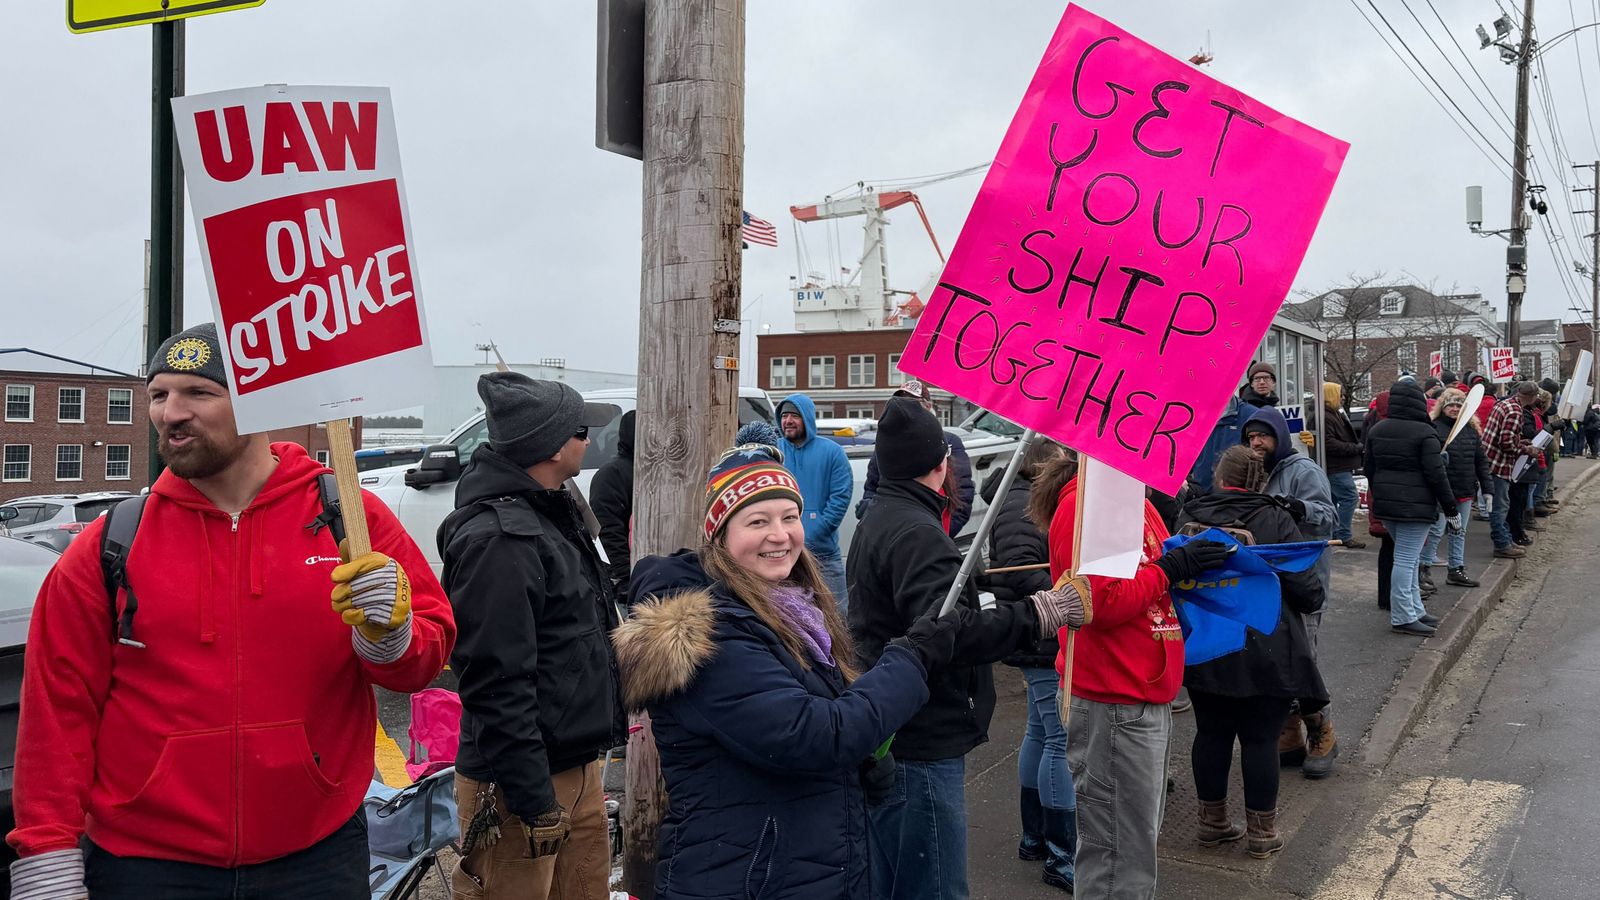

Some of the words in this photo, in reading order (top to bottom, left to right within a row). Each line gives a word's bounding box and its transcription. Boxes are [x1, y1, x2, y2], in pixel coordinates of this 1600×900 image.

[194, 101, 378, 183] UAW
[1072, 36, 1266, 177] GET
[266, 198, 345, 283] ON
[1047, 122, 1253, 286] YOUR
[230, 243, 413, 386] STRIKE
[797, 291, 824, 301] BIW
[1007, 229, 1218, 356] SHIP
[923, 282, 1195, 478] TOGETHER
[1492, 349, 1512, 358] UAW
[1498, 360, 1507, 369] ON
[305, 556, 343, 565] Champ
[400, 571, 409, 602] KINCO
